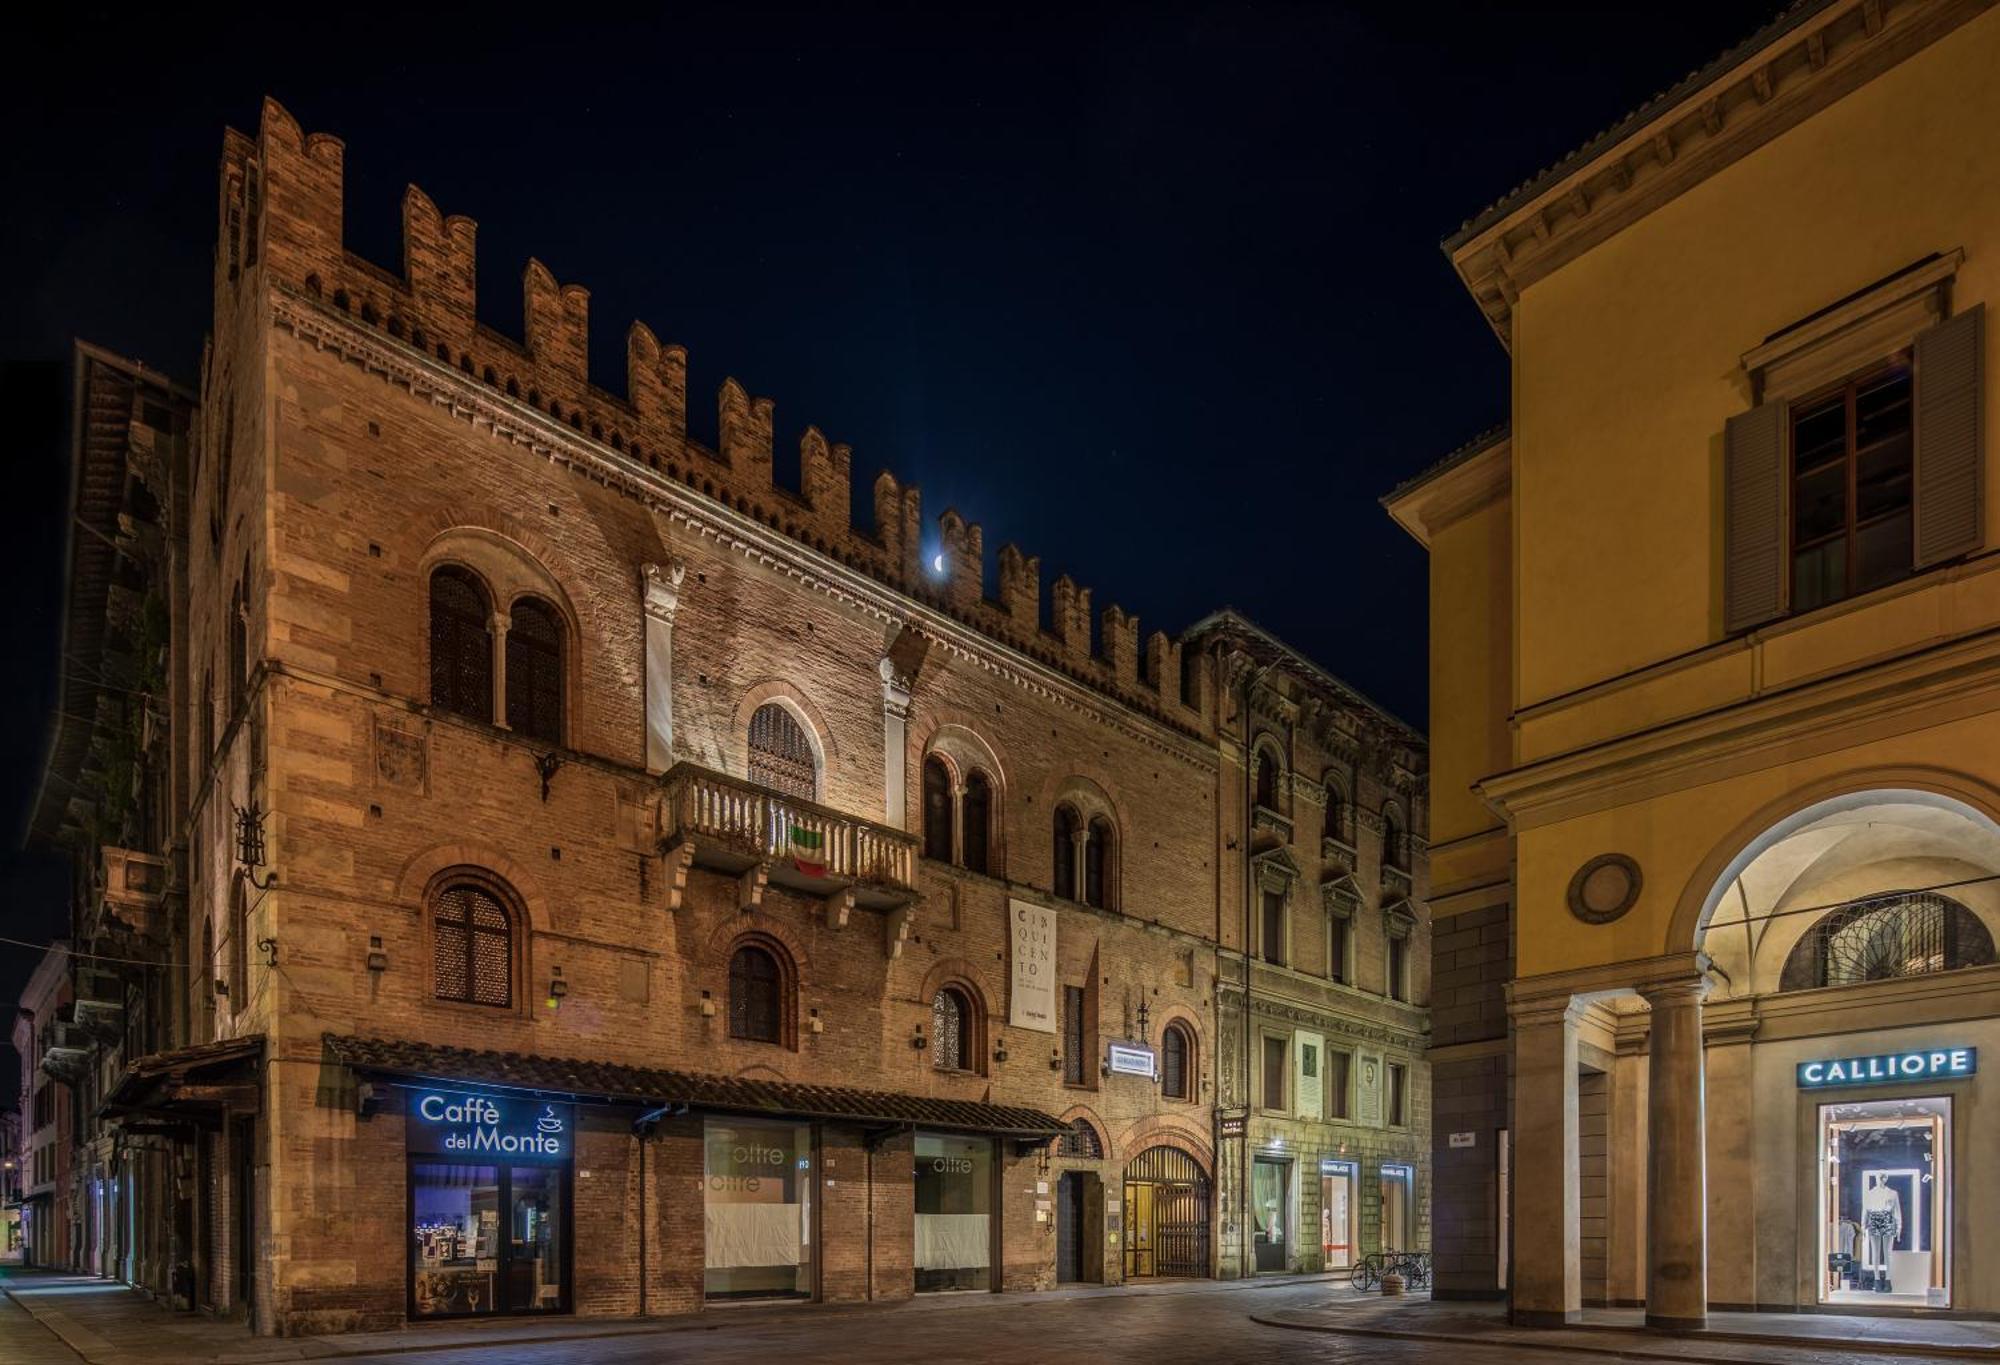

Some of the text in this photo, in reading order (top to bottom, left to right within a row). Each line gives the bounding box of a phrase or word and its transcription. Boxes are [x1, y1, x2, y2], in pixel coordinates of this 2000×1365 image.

[1804, 1051, 1968, 1082] CALLIOPE
[420, 1095, 500, 1125] Caffè
[445, 1126, 560, 1154] del Monte
[733, 1143, 785, 1165] oltre
[934, 1155, 972, 1174] oltre
